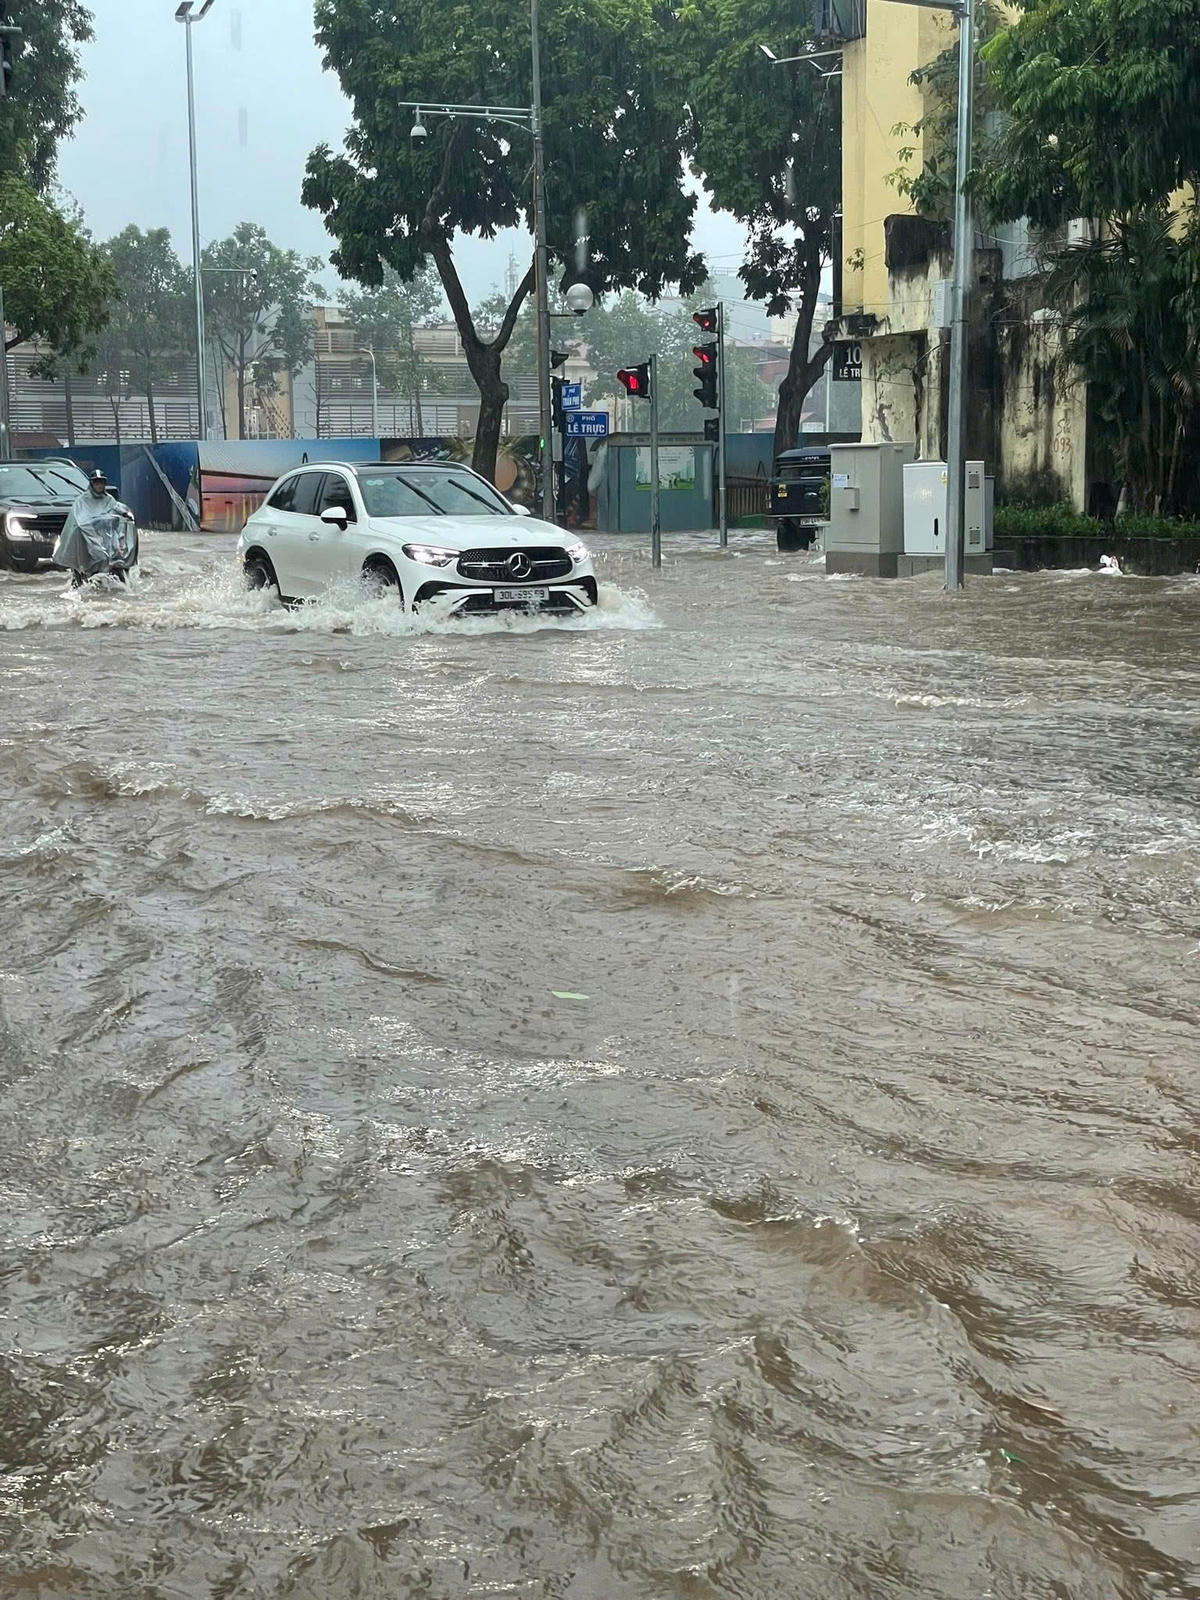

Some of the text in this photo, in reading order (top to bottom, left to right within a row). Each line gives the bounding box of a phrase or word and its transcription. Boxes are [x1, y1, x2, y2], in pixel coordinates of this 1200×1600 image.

[846, 346, 861, 365] 10
[839, 366, 849, 378] LÊ
[567, 422, 605, 435] LÊ TRỰC
